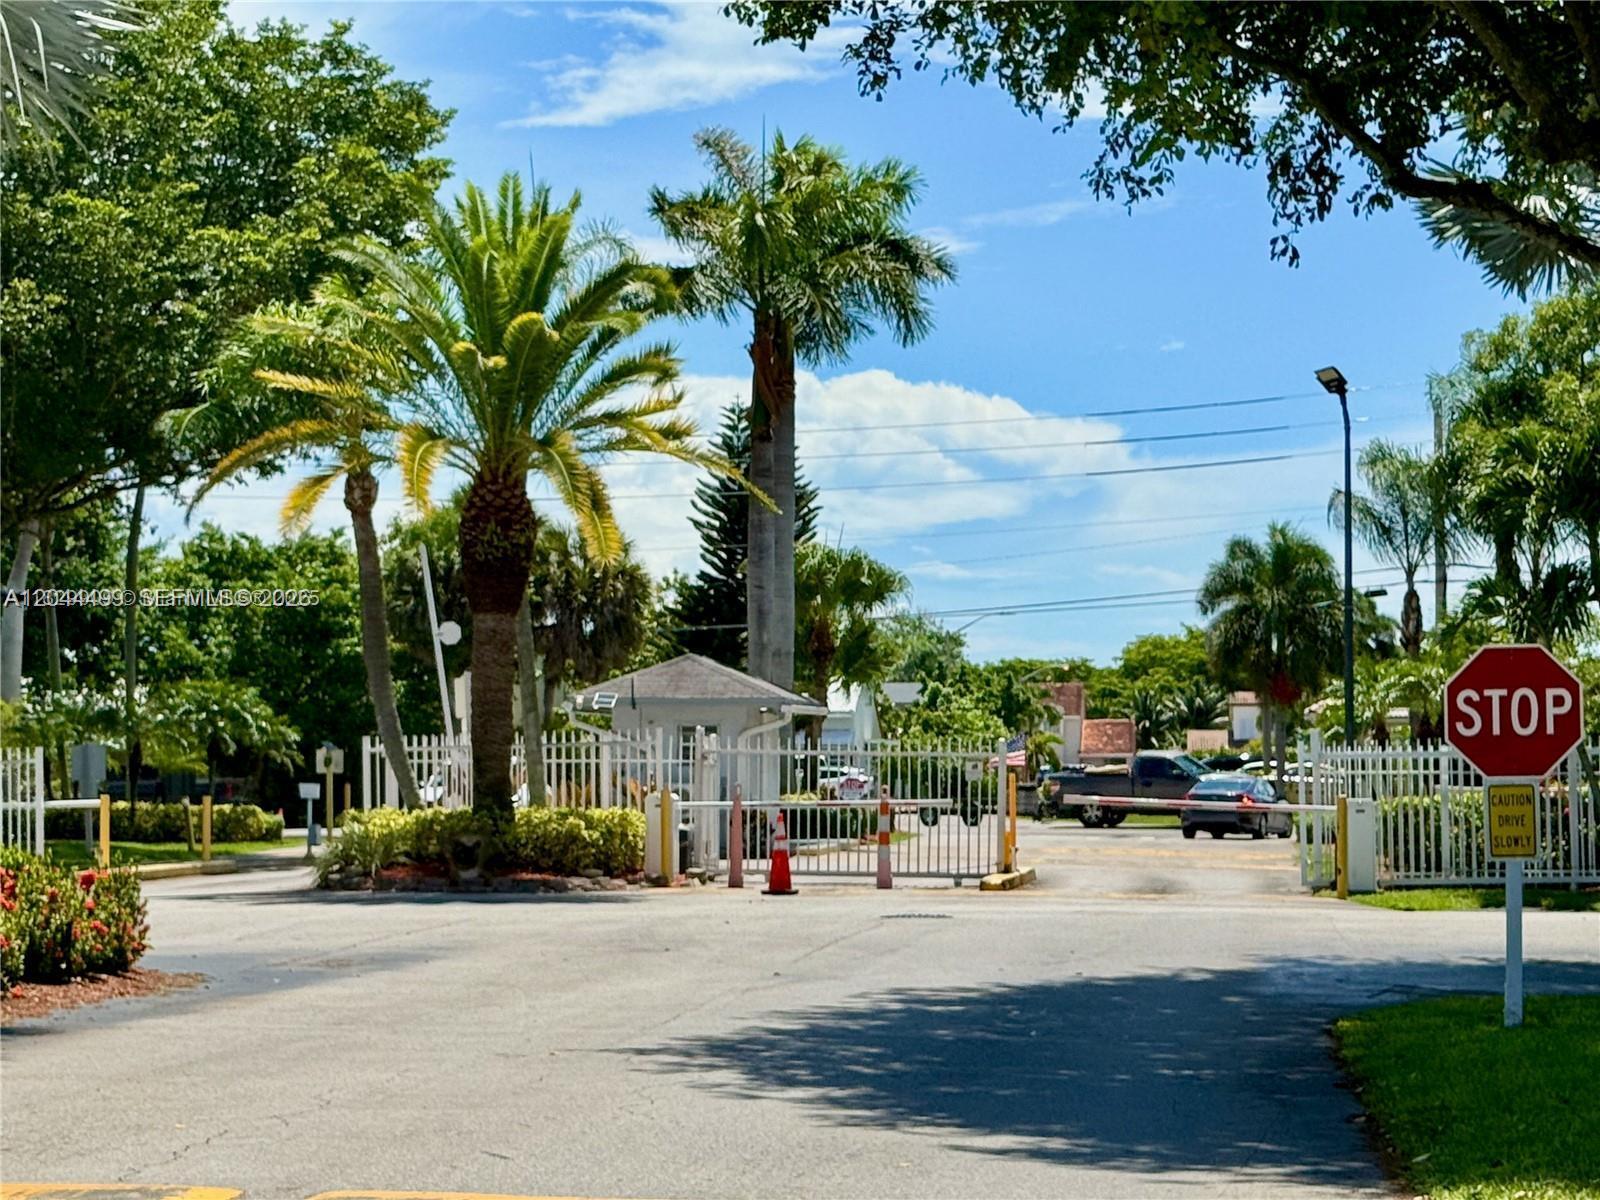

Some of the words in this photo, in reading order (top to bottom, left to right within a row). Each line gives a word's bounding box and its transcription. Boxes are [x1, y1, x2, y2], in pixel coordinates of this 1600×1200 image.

[1455, 687, 1573, 737] STOP
[1491, 794, 1532, 806] CAUTION
[1498, 814, 1526, 827] DRIVE
[1494, 835, 1531, 848] SLOWLY
